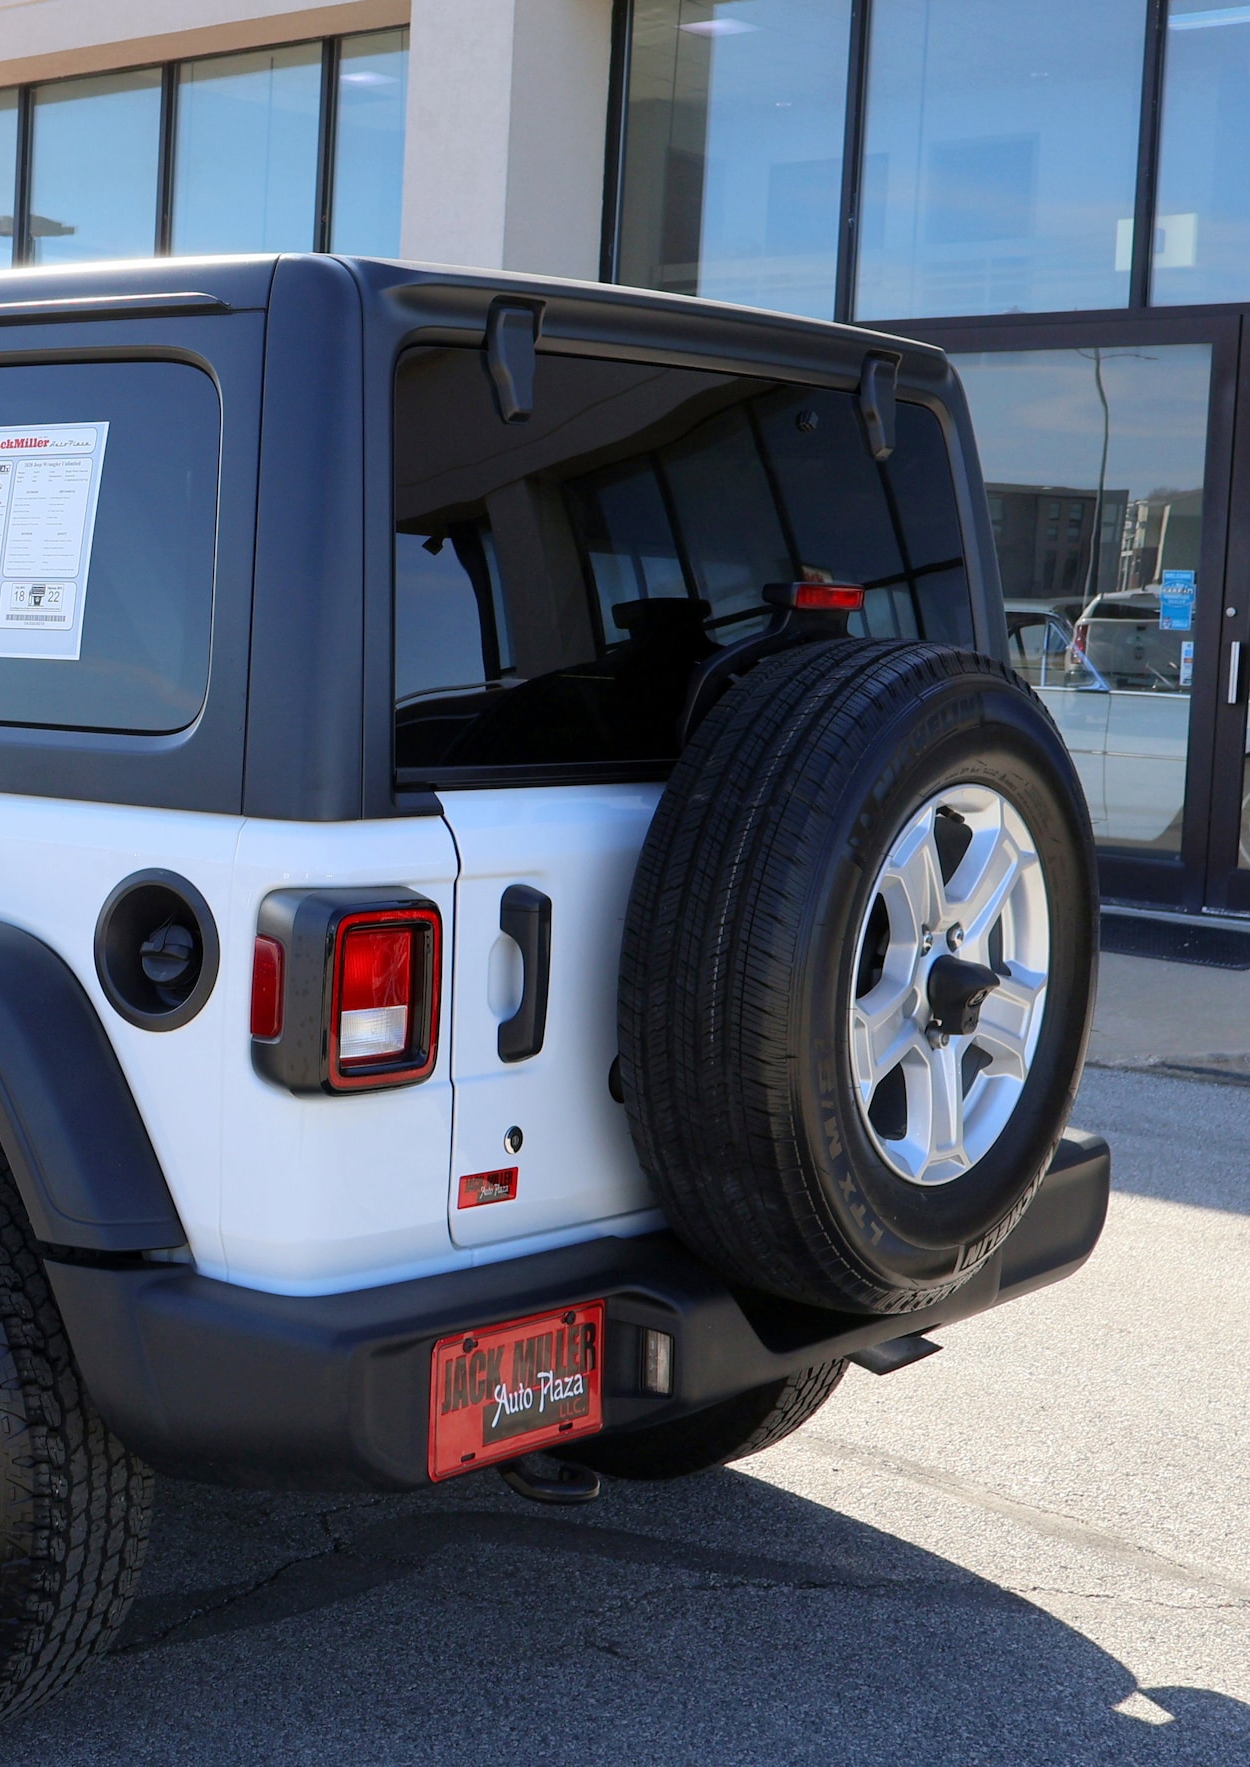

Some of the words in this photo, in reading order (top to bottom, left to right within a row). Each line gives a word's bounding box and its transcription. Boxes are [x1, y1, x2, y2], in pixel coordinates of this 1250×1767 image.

[14, 591, 25, 602] 18
[47, 591, 60, 602] 22
[493, 1184, 509, 1196] Plaza
[441, 1344, 505, 1416] JACK
[513, 1322, 596, 1391] MILLER
[491, 1383, 534, 1428] Auto
[537, 1370, 584, 1413] Plaza
[558, 1398, 585, 1418] LLC.
